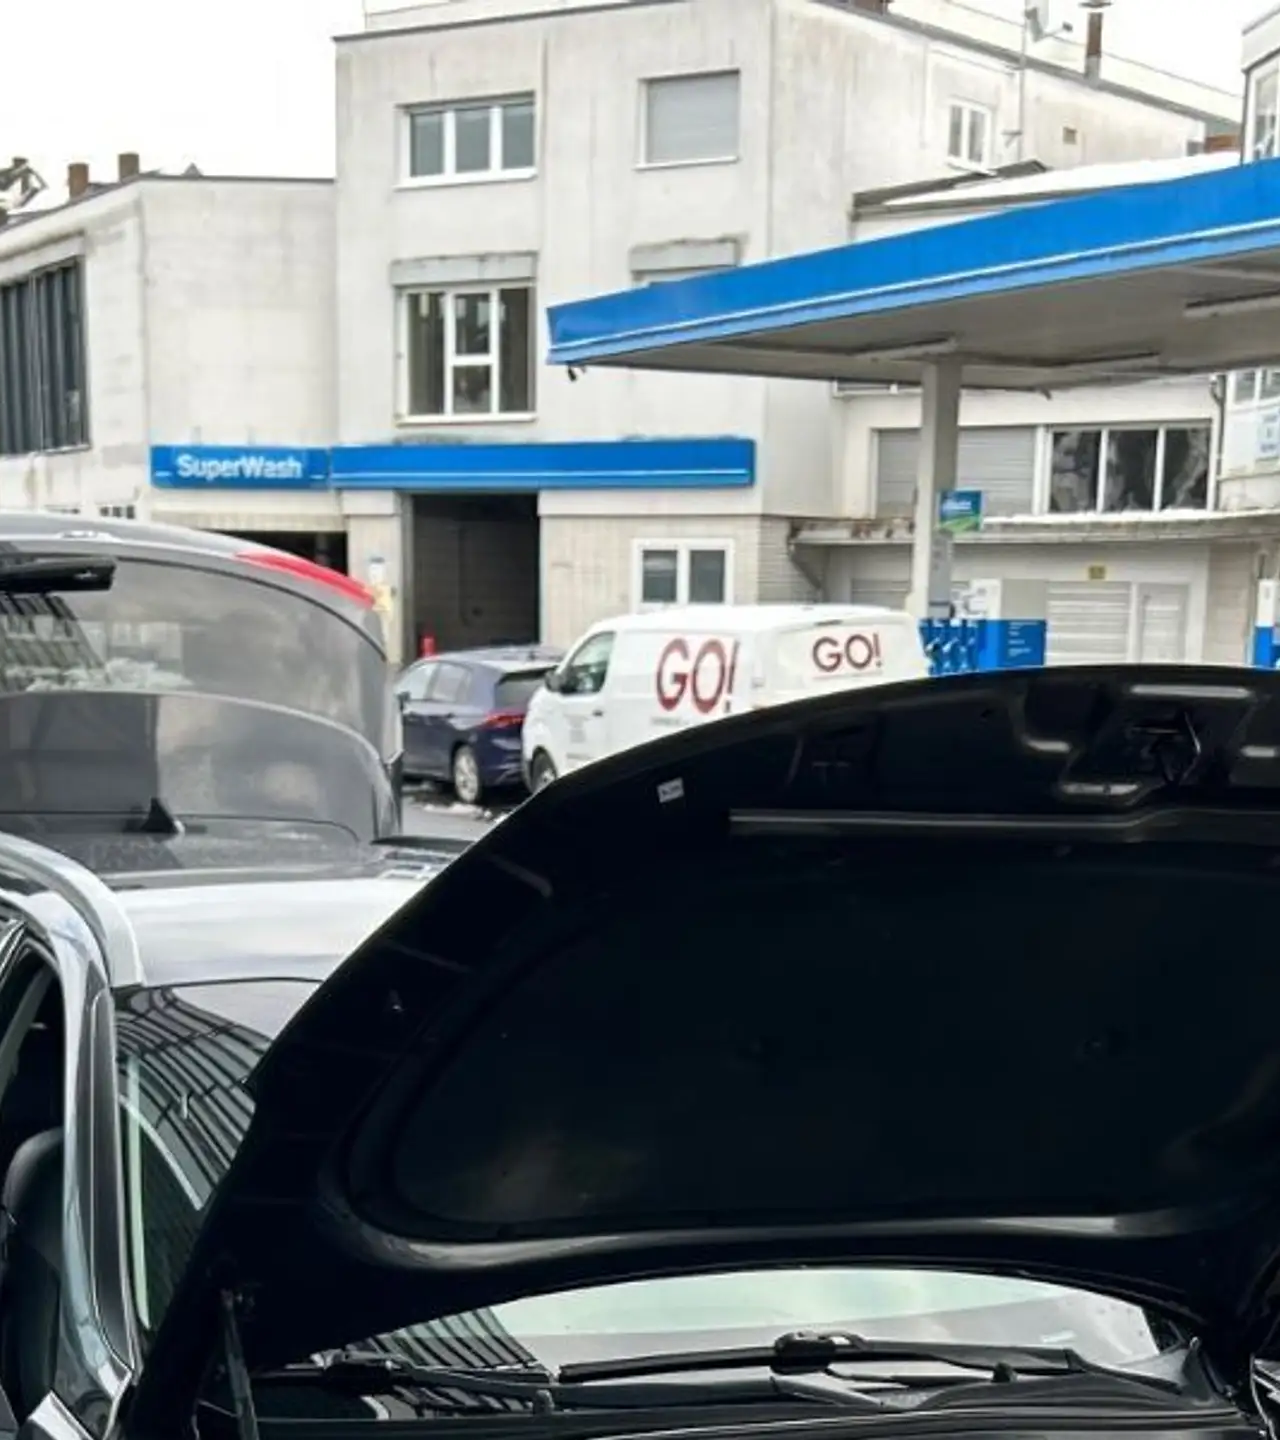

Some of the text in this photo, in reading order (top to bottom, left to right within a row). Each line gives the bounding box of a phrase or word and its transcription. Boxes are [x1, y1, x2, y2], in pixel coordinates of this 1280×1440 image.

[177, 453, 304, 481] SuperWash
[812, 631, 883, 673] GO!
[656, 637, 741, 714] GO!
